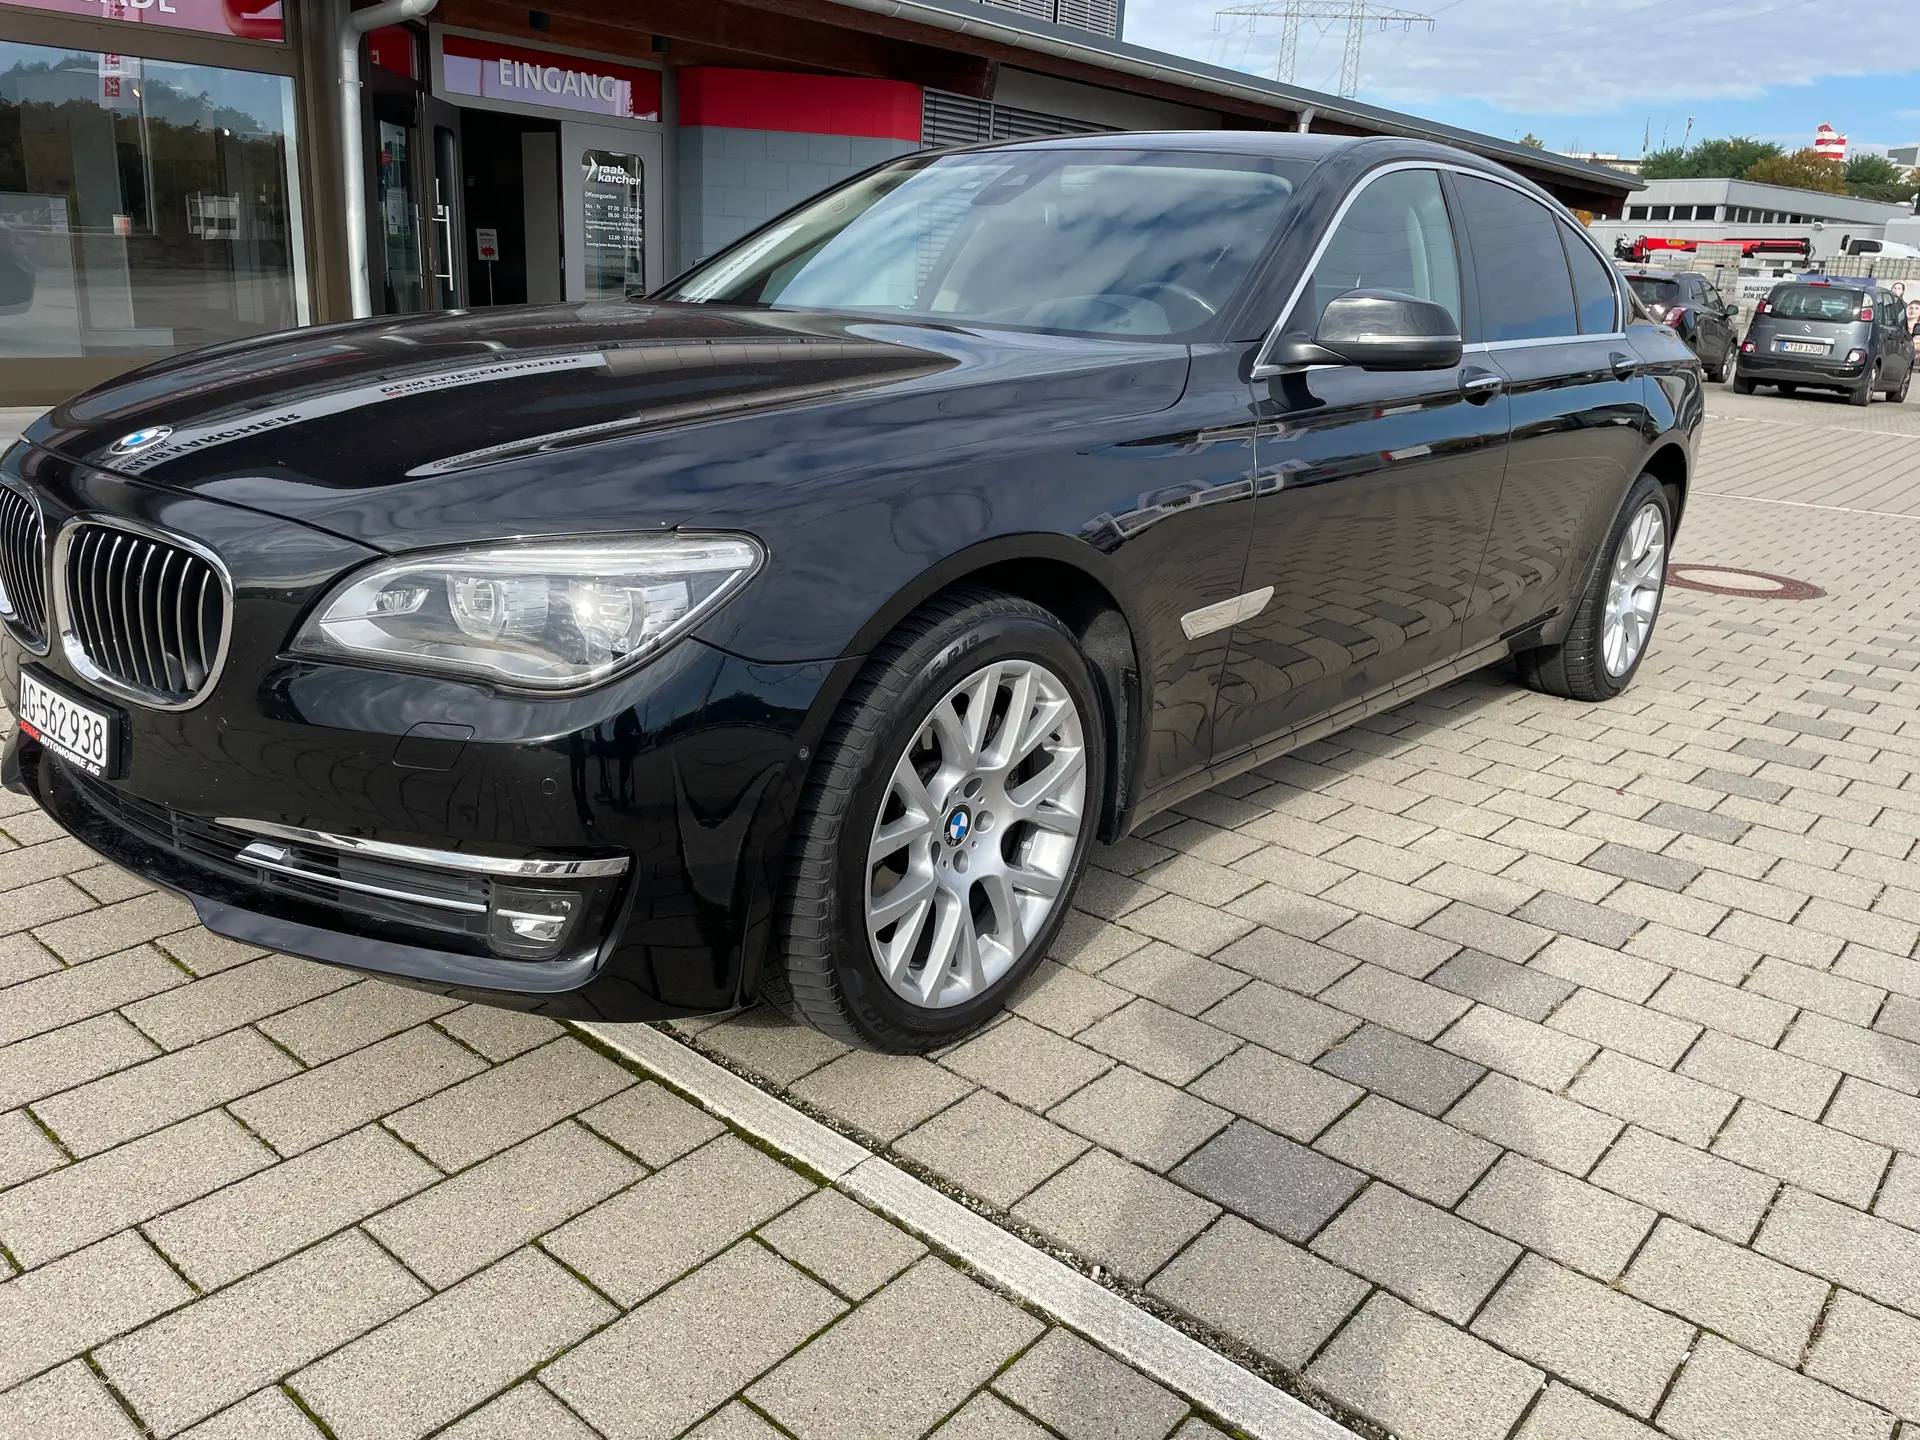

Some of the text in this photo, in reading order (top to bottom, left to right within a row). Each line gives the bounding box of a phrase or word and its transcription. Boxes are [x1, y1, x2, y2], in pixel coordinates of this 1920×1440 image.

[500, 58, 616, 102] EINGANG
[597, 173, 641, 186] karcher
[599, 165, 625, 175] raab
[40, 734, 86, 769] AUTOMOBILE
[86, 762, 101, 777] AG
